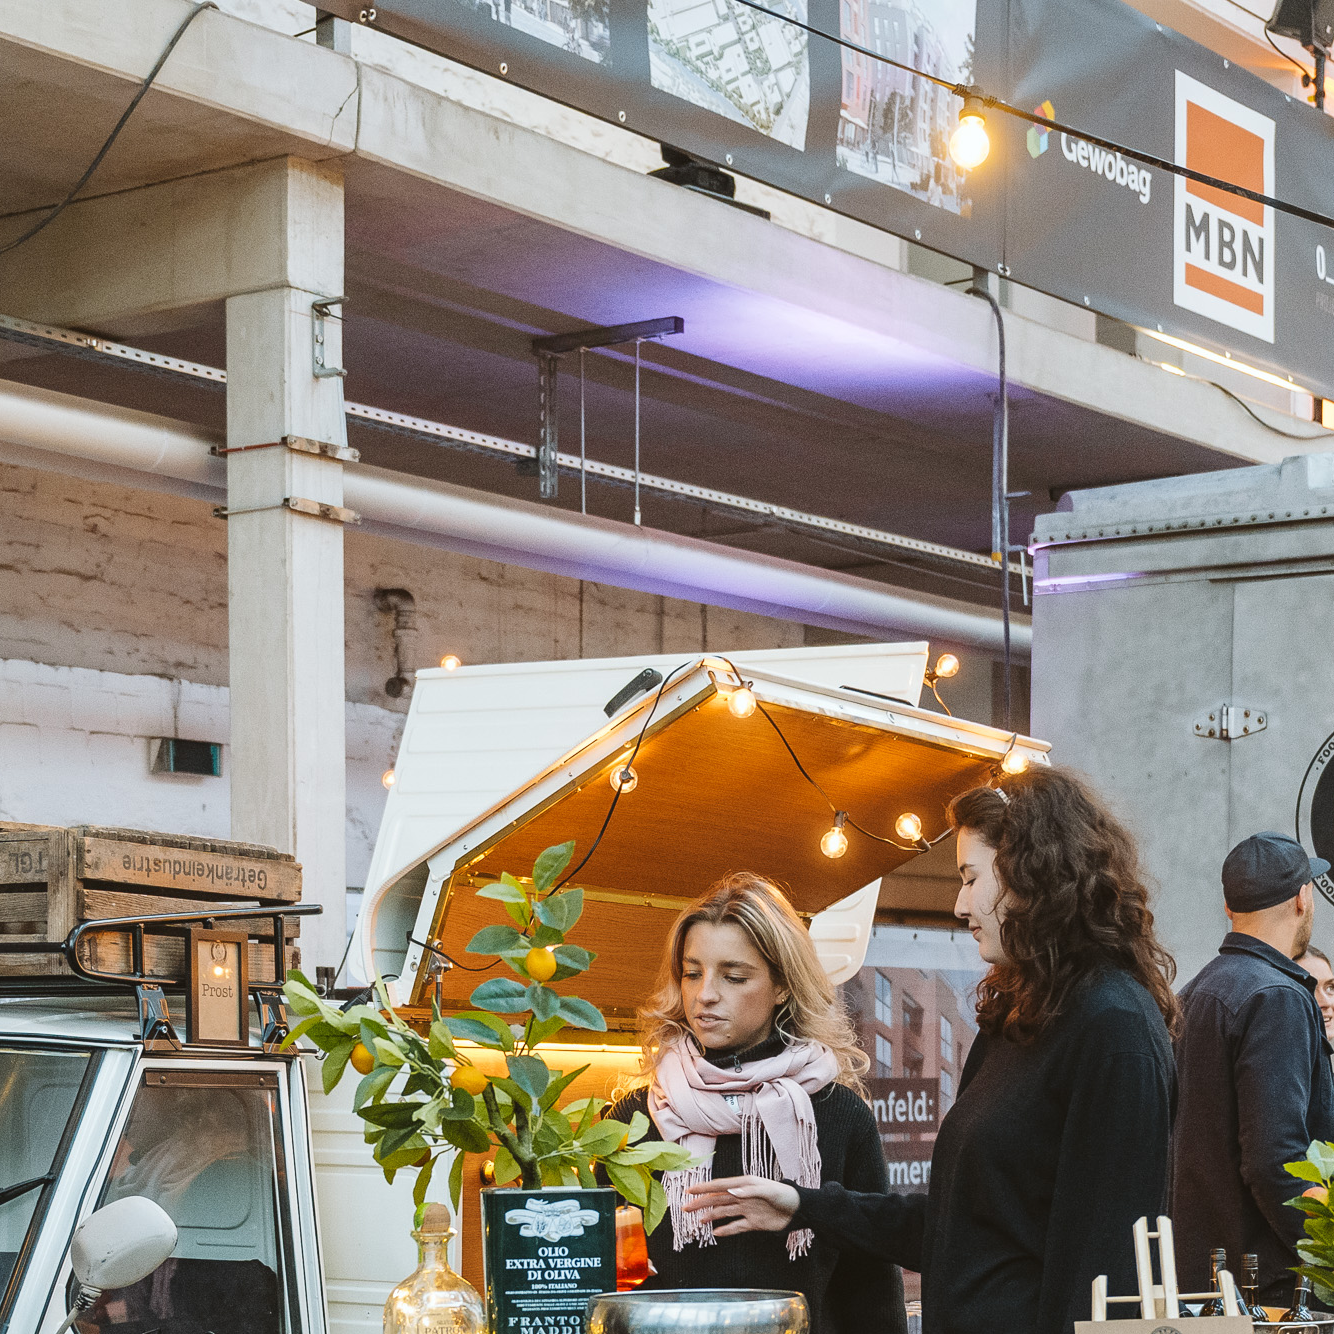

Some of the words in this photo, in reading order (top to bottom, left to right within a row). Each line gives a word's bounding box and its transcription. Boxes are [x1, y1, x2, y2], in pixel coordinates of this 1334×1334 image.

[1060, 131, 1152, 205] Gewobag
[1185, 203, 1265, 285] MBN
[123, 854, 267, 891] Getränkeindustrie
[201, 983, 234, 998] Prost
[873, 1090, 934, 1124] nfeld:
[538, 1246, 569, 1258] OLIO
[505, 1258, 546, 1270] EXTRA
[547, 1257, 602, 1269] VERGINE
[527, 1270, 543, 1281] DI
[544, 1269, 581, 1280] OLIVA
[548, 1282, 578, 1290] ITALIANO
